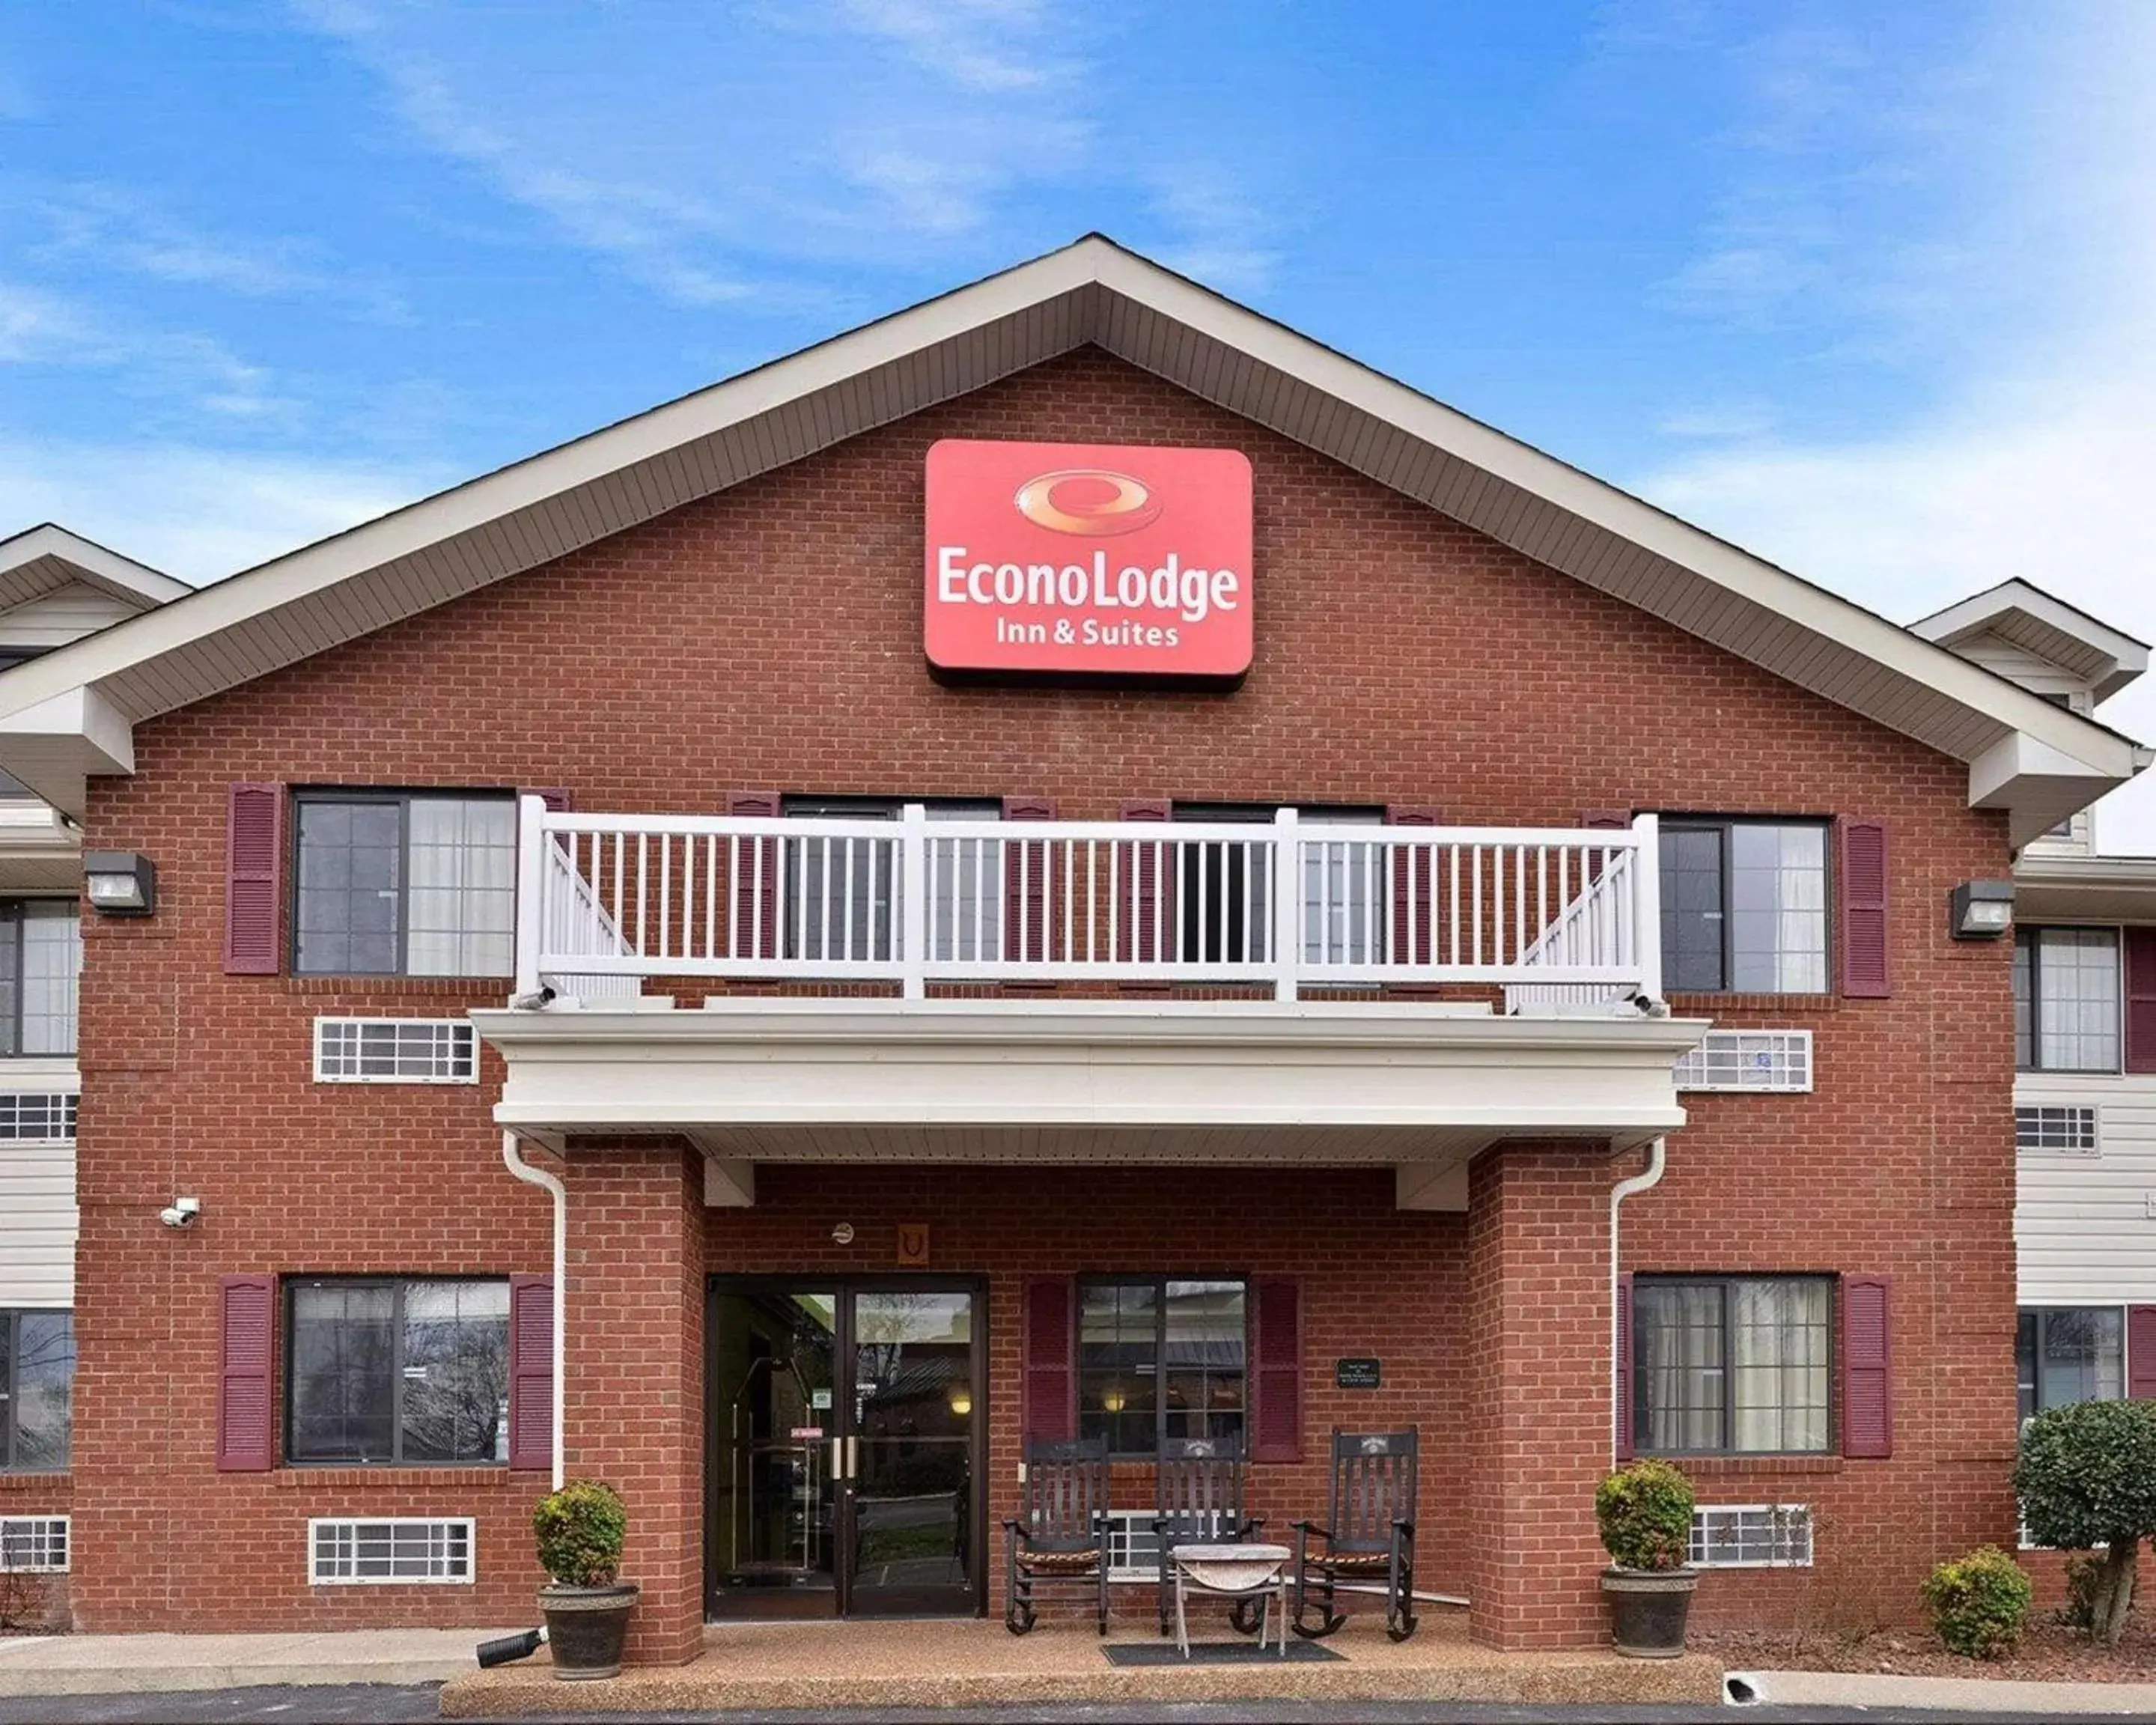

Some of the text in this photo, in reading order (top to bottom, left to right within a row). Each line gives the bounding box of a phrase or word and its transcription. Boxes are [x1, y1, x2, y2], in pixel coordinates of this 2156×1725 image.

[996, 616, 1179, 647] Inn & Suites
